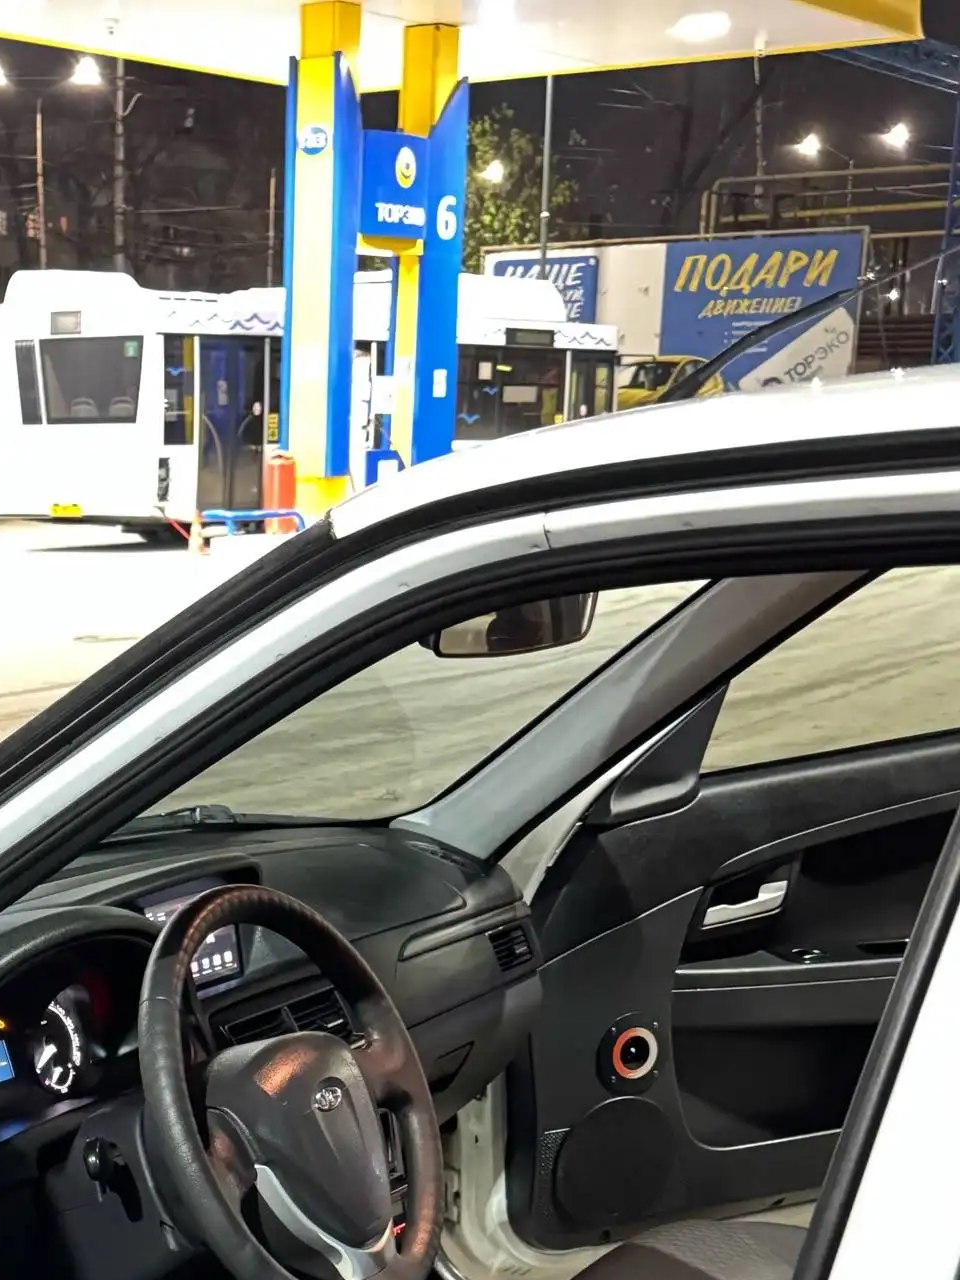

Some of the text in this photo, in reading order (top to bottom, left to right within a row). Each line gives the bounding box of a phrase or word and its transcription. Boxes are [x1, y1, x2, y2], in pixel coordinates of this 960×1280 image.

[436, 194, 457, 241] 6
[673, 248, 839, 297] ПОДАРИ
[784, 331, 850, 383] ТОРЭКО
